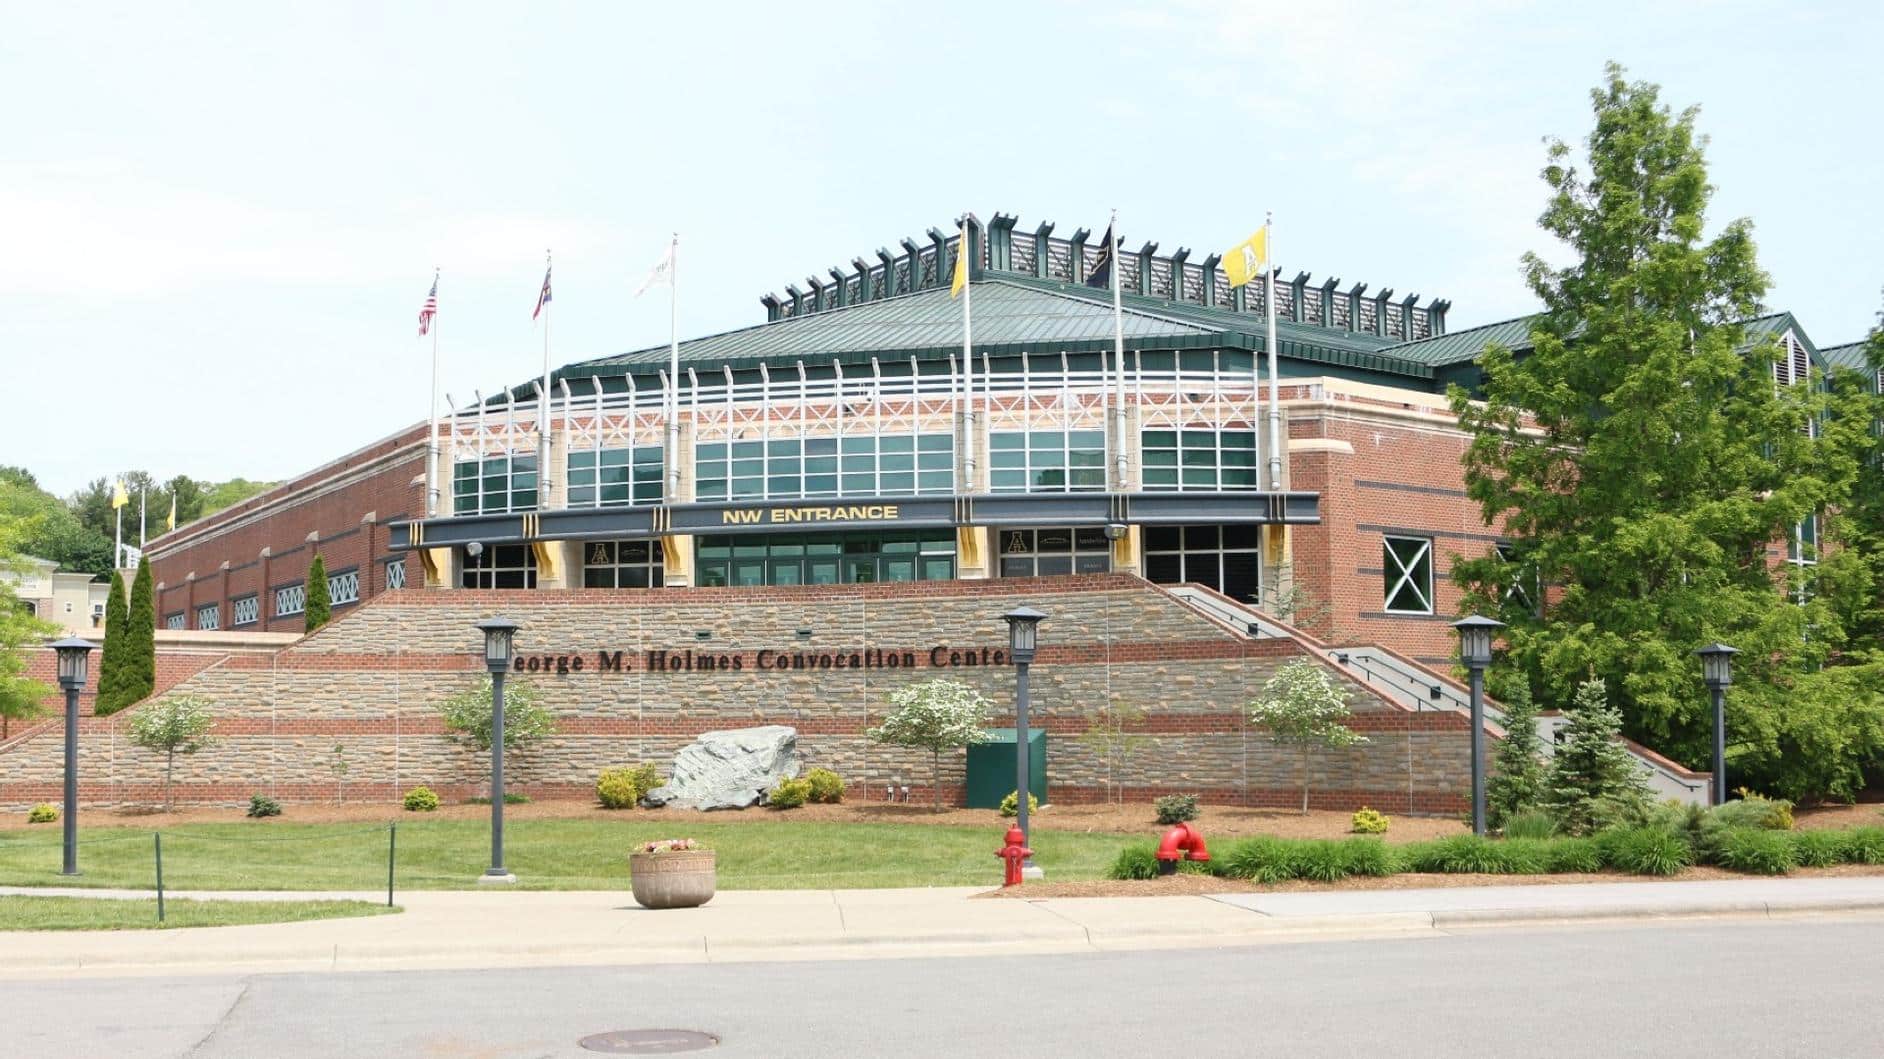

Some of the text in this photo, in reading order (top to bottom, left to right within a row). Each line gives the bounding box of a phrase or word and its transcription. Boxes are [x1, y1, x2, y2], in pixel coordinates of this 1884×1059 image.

[722, 505, 898, 524] NW ENTRANCE
[513, 655, 584, 675] eorge
[599, 650, 632, 671] M.
[647, 649, 743, 671] Holmes
[757, 648, 915, 672] Convocation
